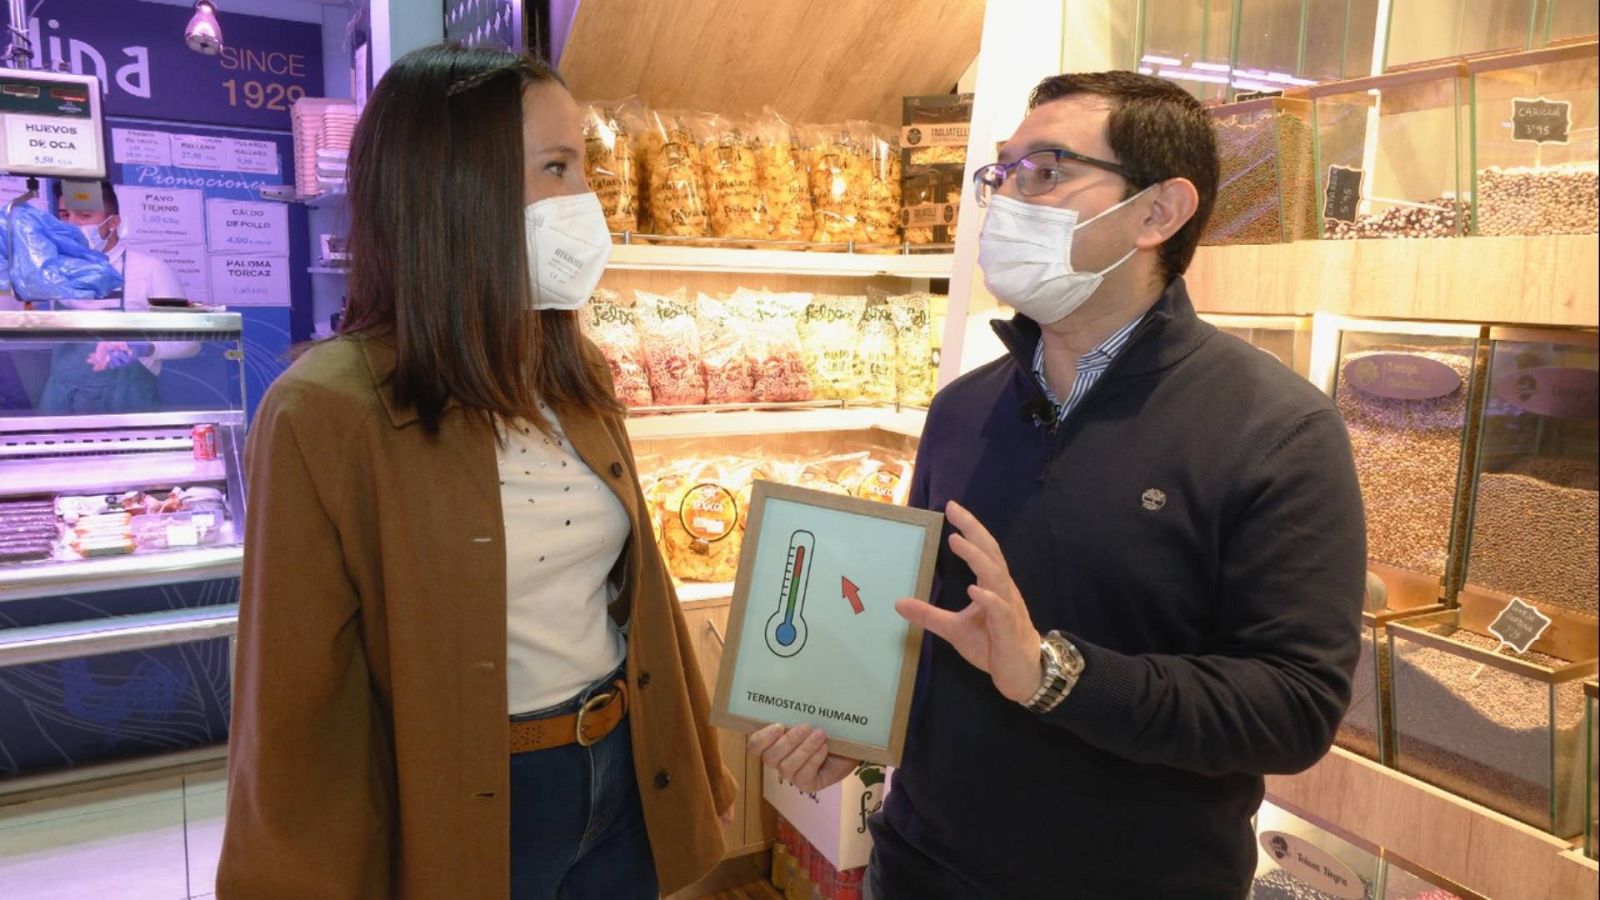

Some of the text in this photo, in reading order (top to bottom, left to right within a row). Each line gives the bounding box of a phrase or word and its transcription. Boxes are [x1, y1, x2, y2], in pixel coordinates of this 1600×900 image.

[220, 46, 306, 77] SINCE
[222, 79, 306, 111] 1929
[25, 123, 78, 135] HUEVOS
[29, 138, 77, 150] DE OCA
[145, 193, 174, 202] PAVO
[226, 219, 271, 229] DE POLLO
[226, 259, 272, 268] PALOMA
[227, 268, 272, 278] TORCAZ
[746, 690, 869, 726] TERMOSTATO HUMANO
